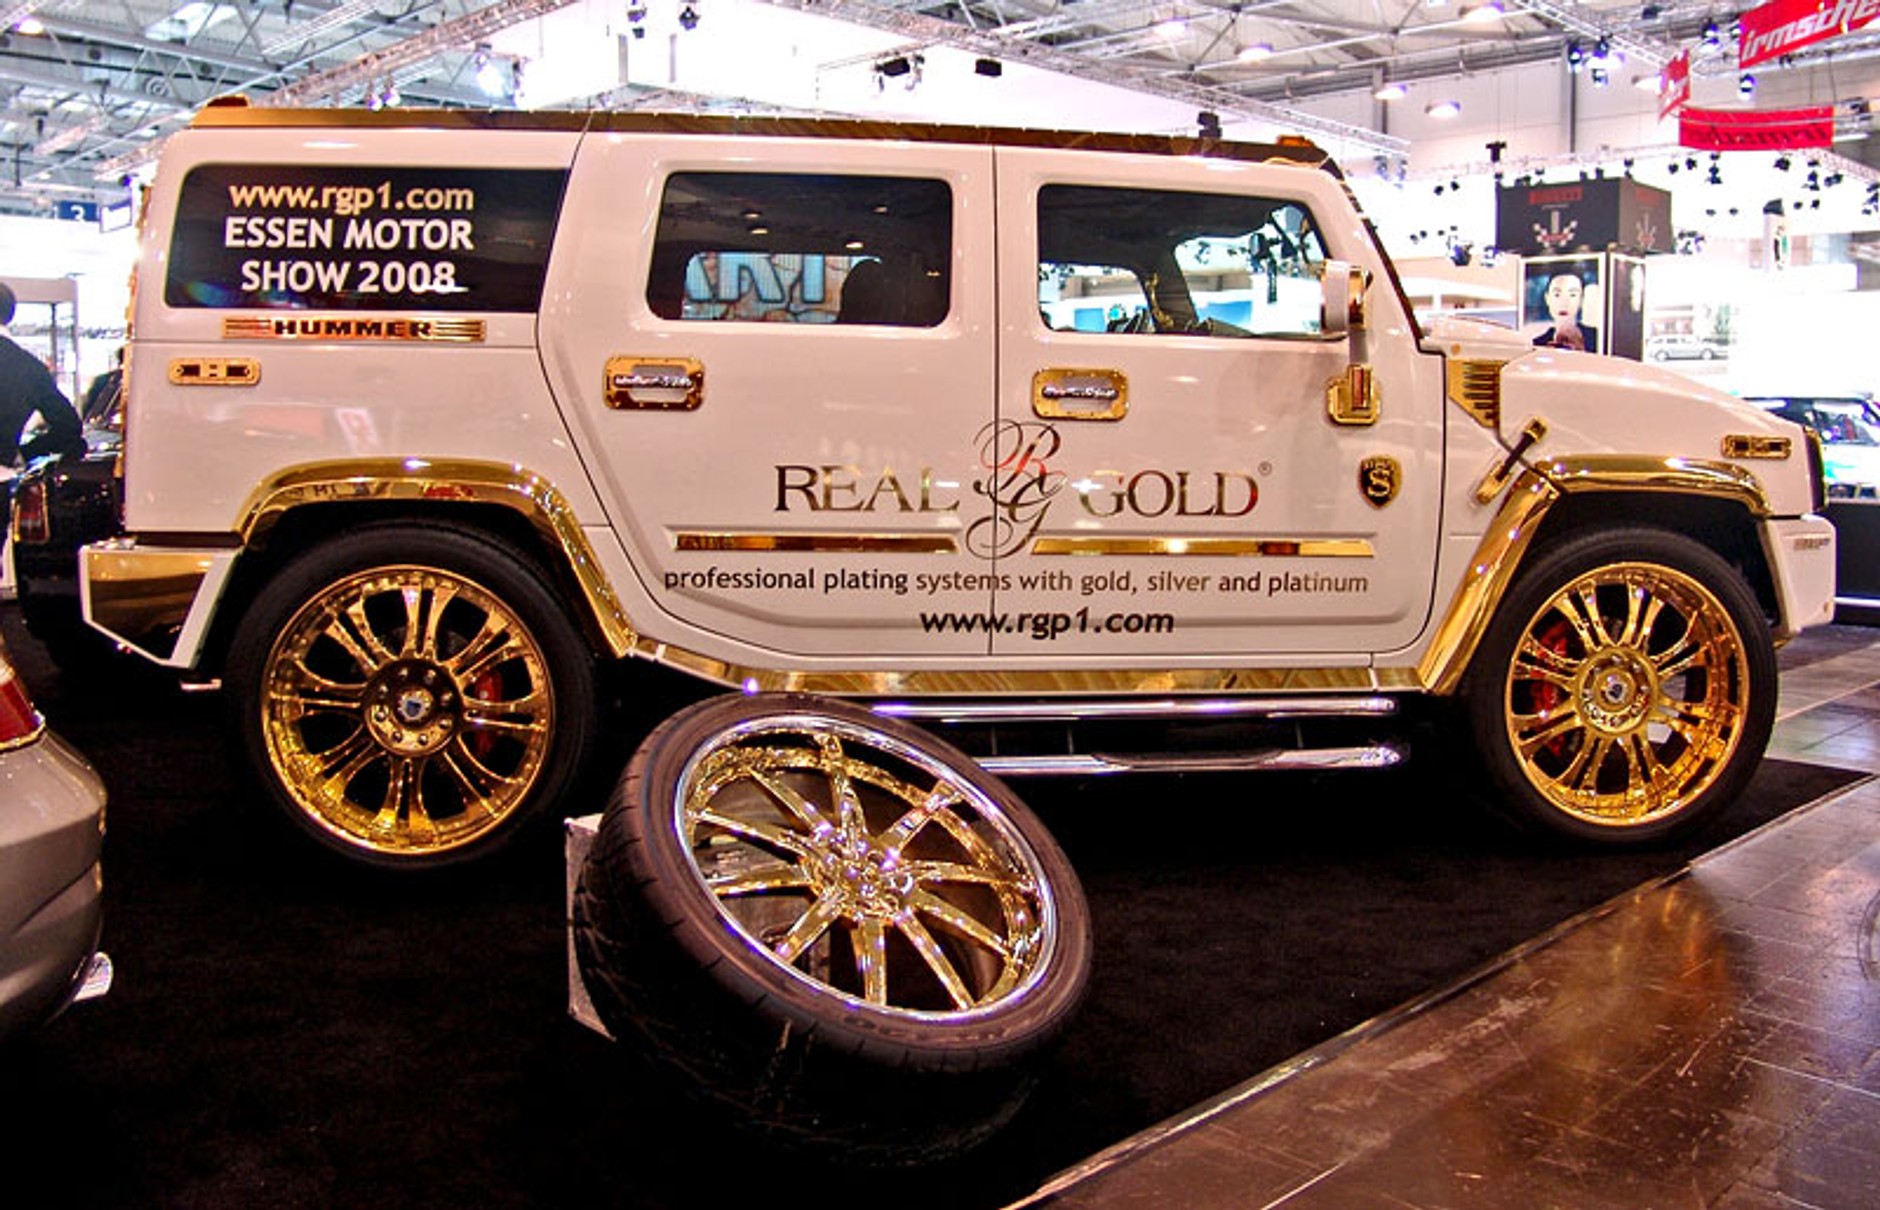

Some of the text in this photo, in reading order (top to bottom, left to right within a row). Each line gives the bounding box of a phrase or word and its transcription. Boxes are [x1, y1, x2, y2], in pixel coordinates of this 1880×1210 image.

[228, 181, 474, 216] www.rgp1.com
[225, 216, 474, 250] ESSEN MOTOR
[241, 260, 457, 294] SHOW 2008
[274, 319, 432, 337] HUMMER
[773, 464, 959, 512] REAL
[664, 566, 1369, 597] professional plating systems with gold, silver and platinum
[920, 606, 1175, 640] www.rgp1.com
